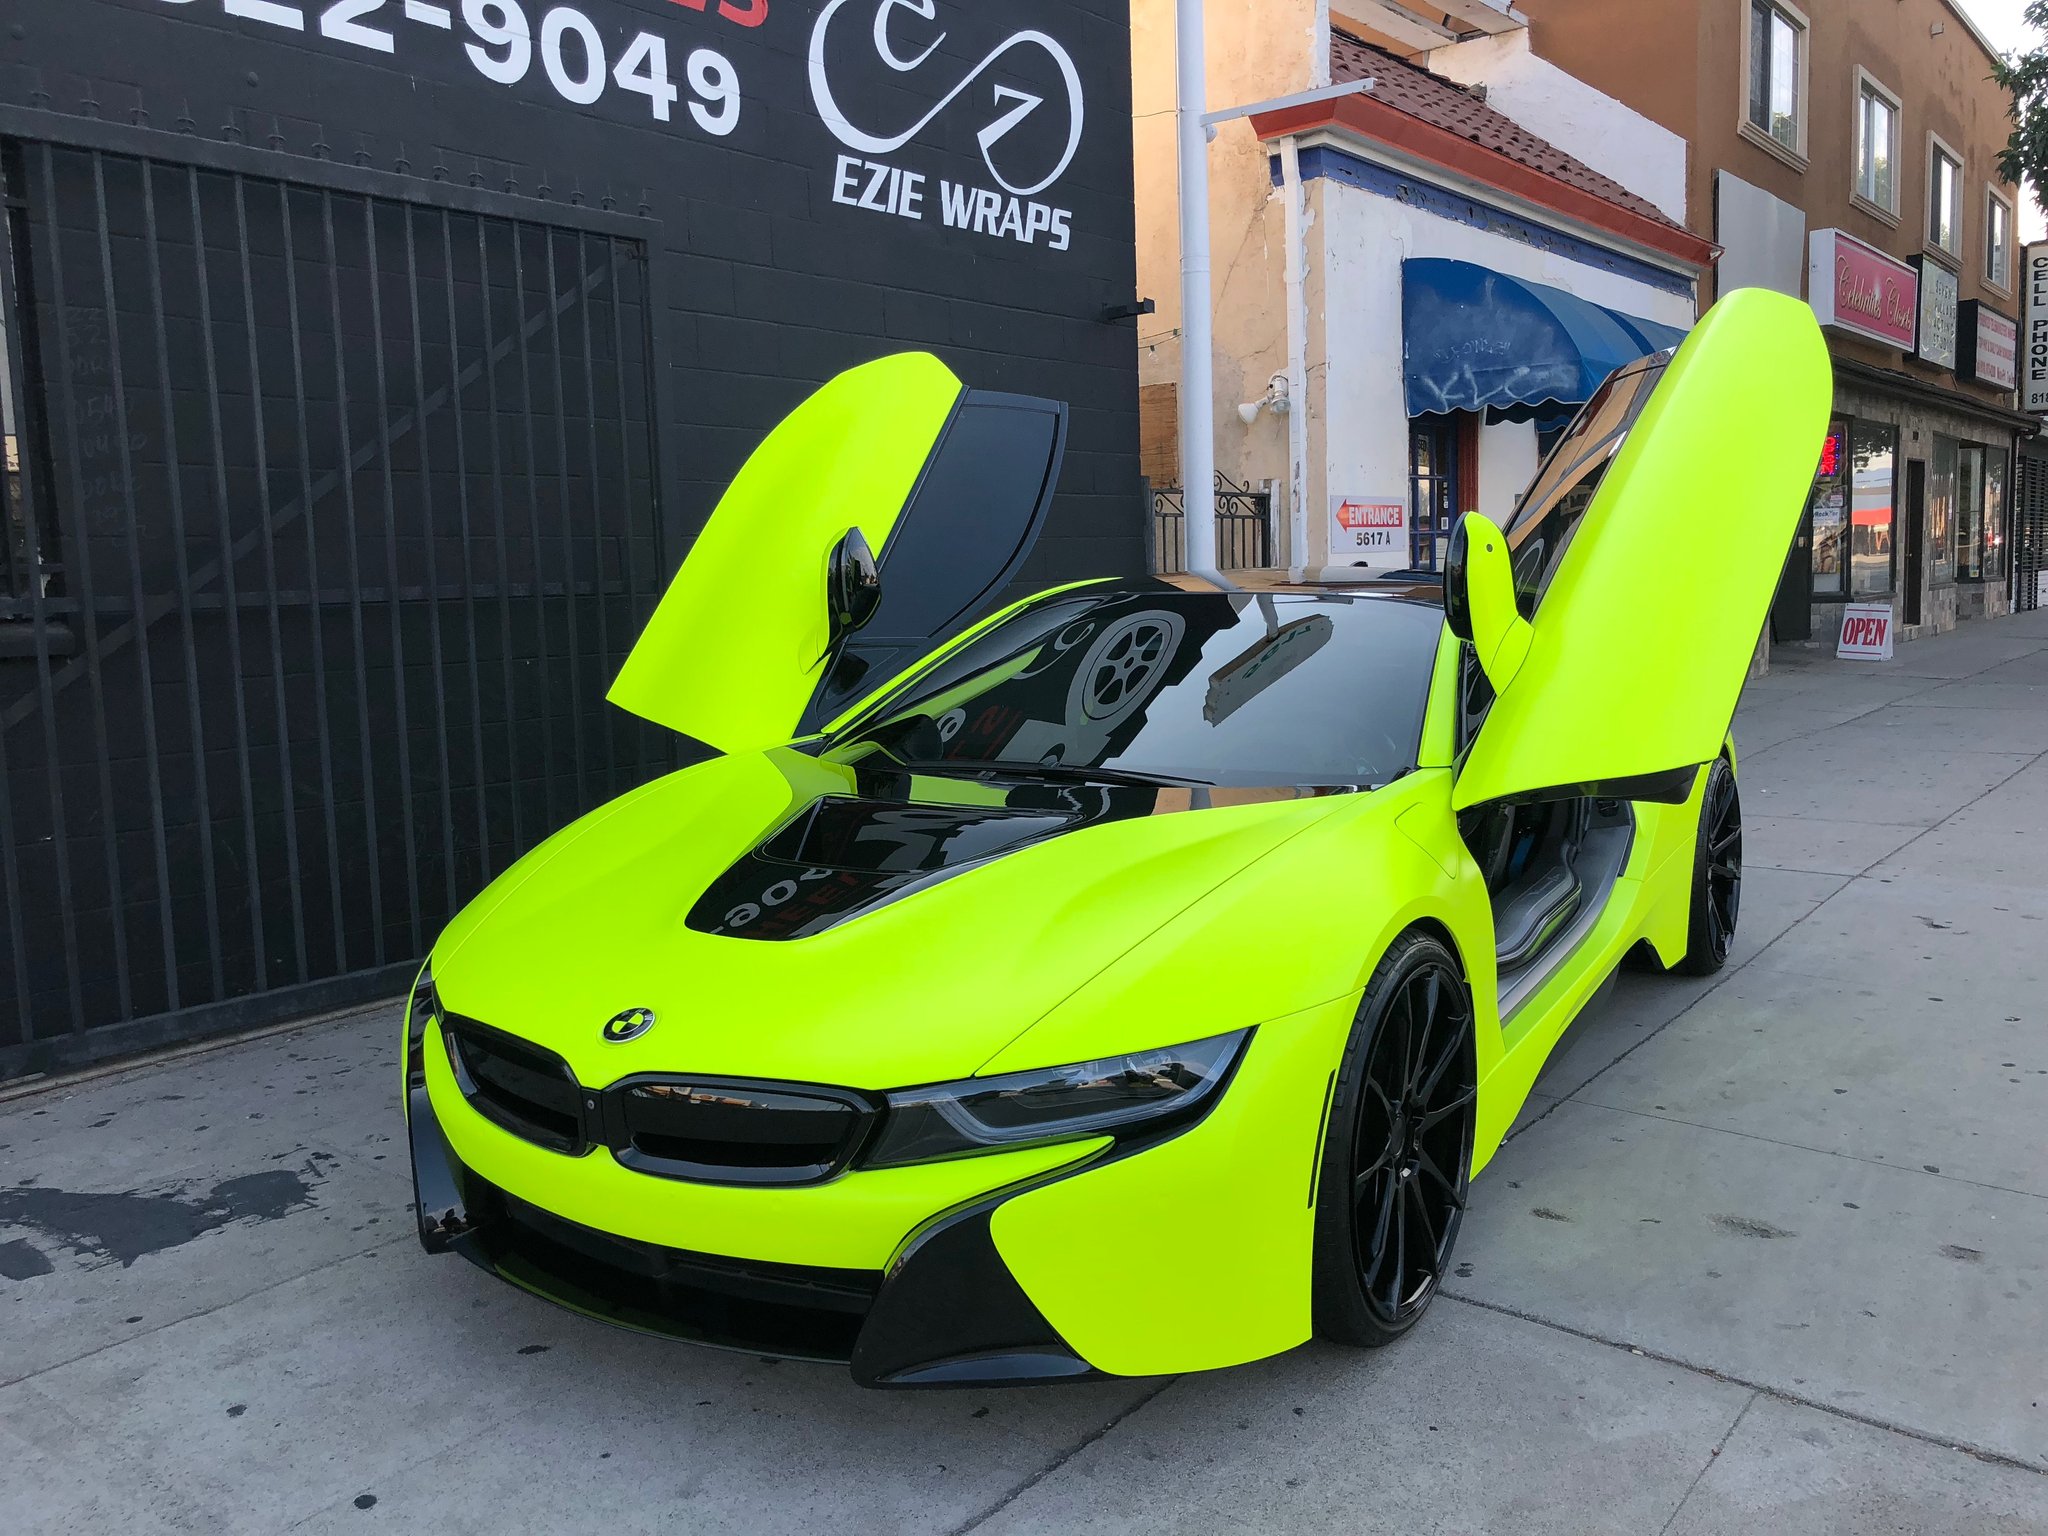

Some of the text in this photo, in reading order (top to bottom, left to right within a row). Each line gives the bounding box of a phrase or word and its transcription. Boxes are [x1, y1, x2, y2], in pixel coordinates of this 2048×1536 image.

[832, 154, 1073, 251] EZIE WRAPS
[2031, 320, 2048, 381] PHONE
[1348, 506, 1400, 525] ENTRANCE
[1356, 531, 1391, 546] 5617 A
[1842, 617, 1888, 647] OPEN
